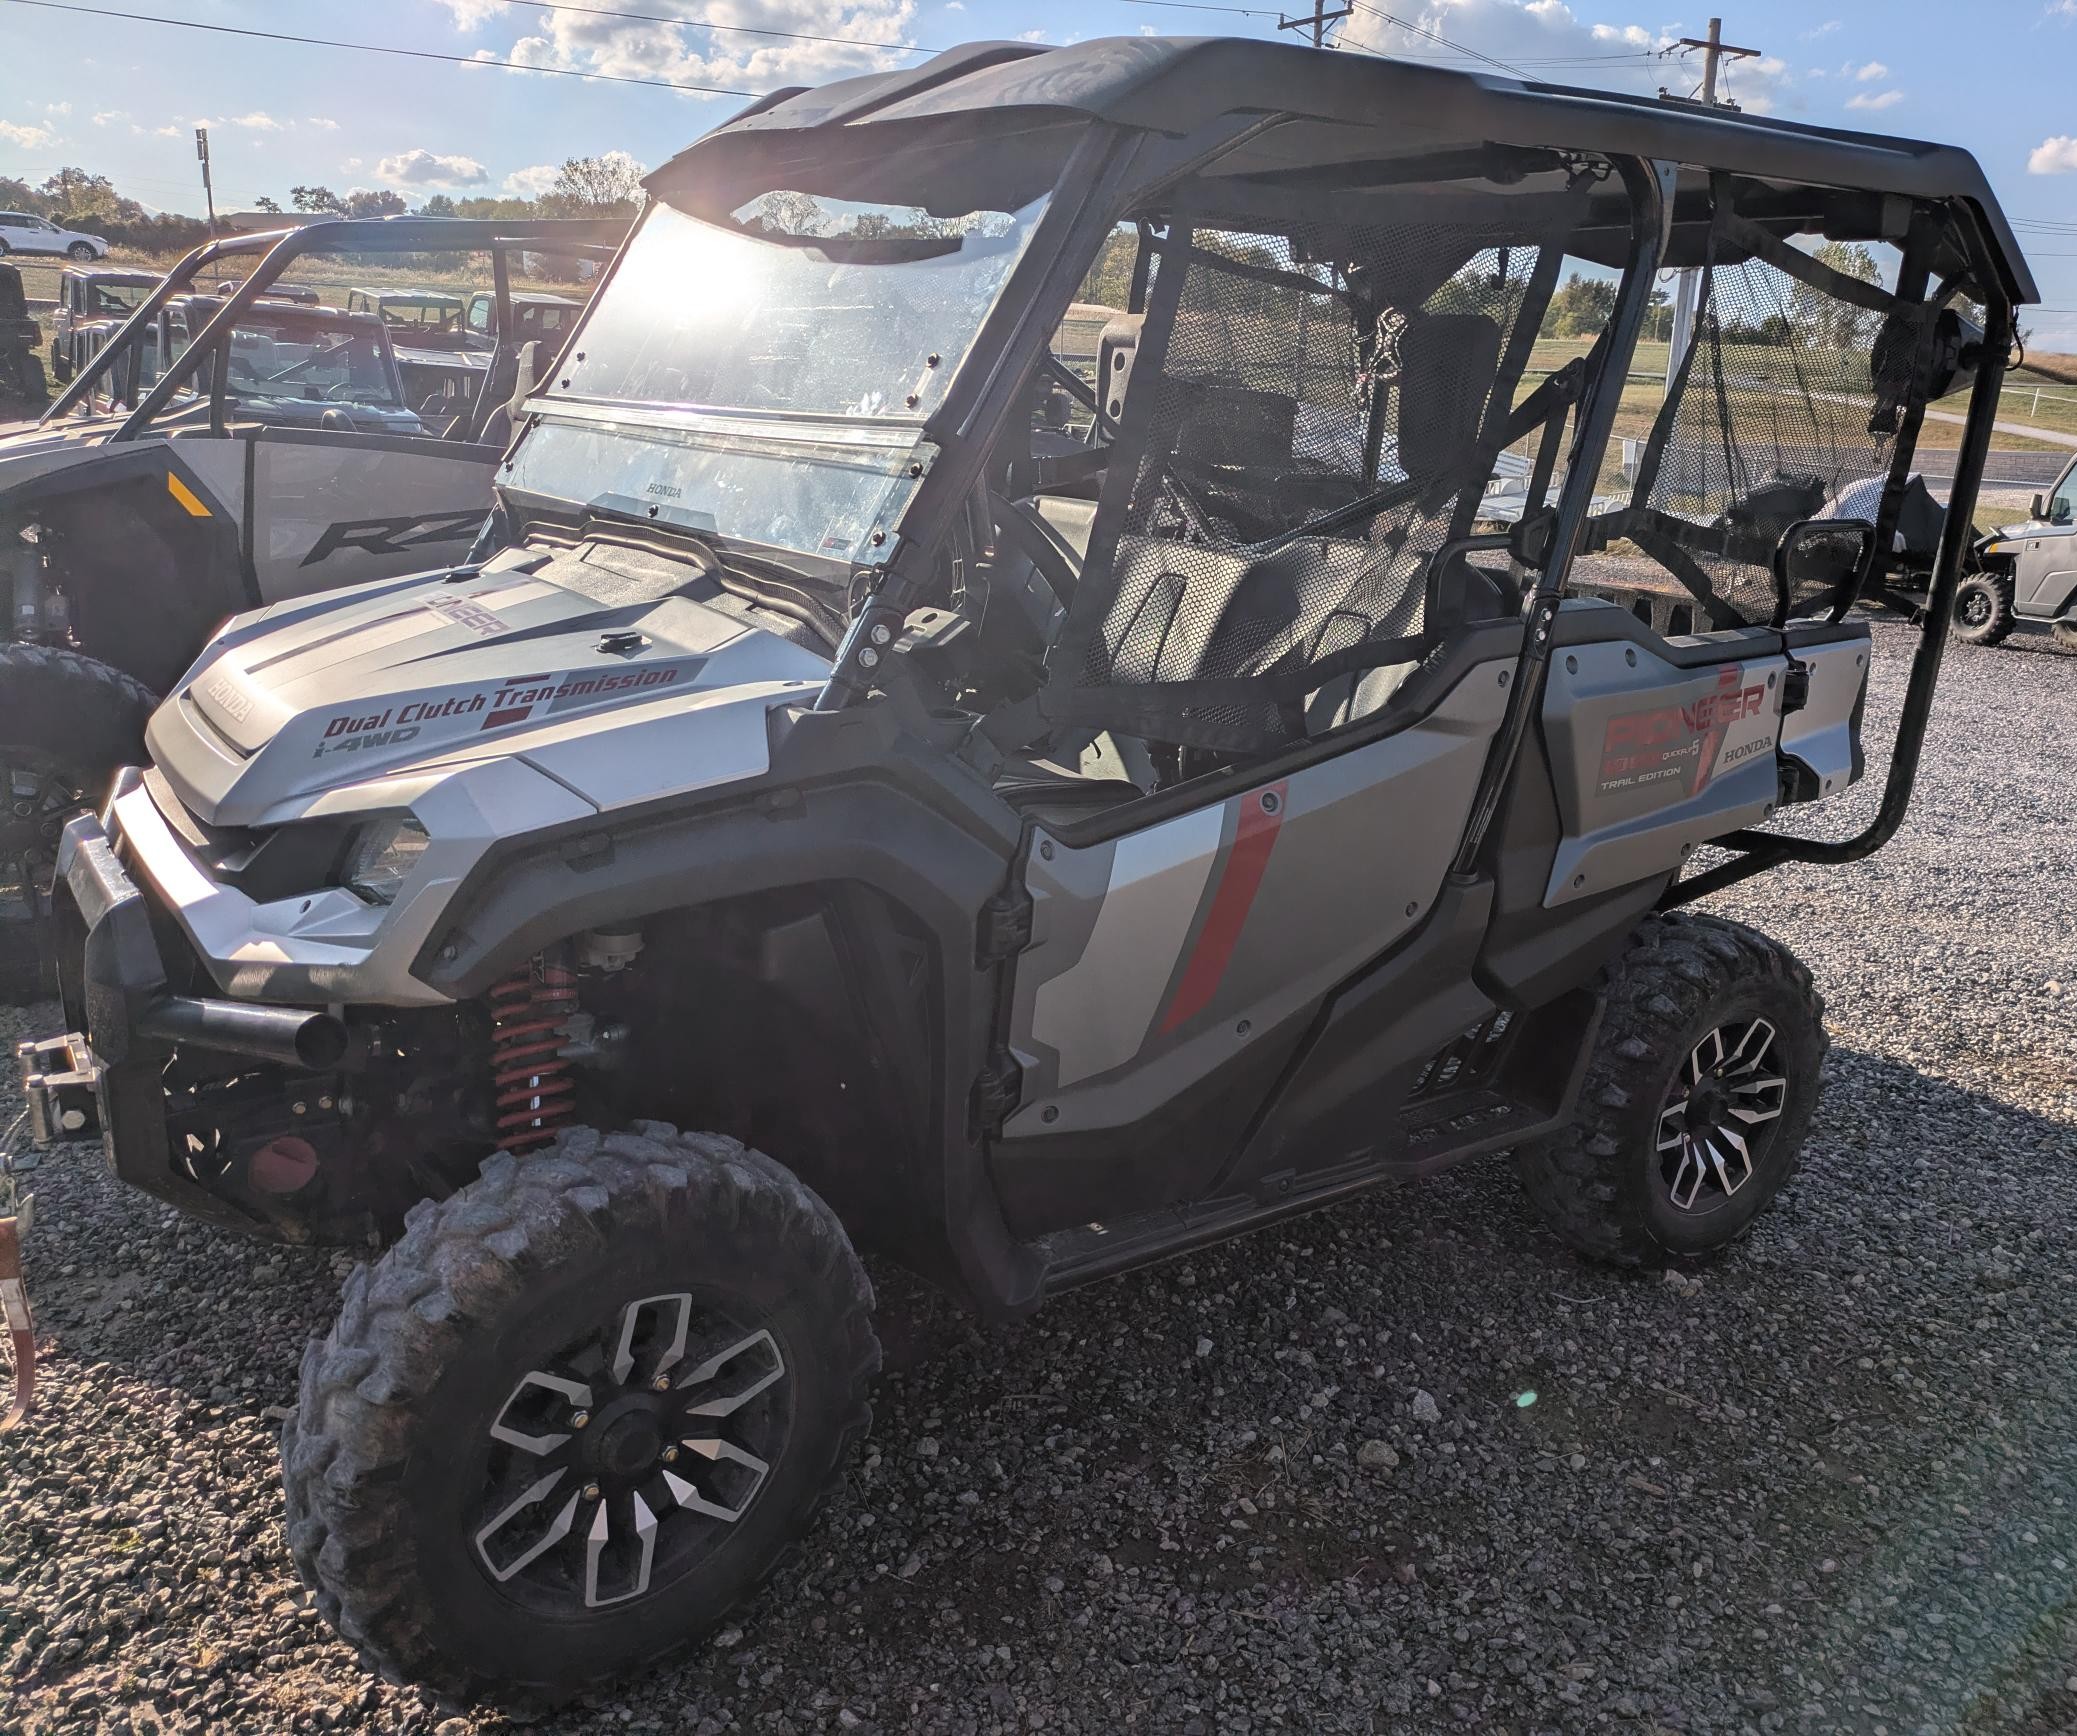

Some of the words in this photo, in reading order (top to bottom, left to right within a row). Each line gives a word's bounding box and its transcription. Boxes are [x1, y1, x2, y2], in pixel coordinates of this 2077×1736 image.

[645, 482, 682, 499] HONDA
[207, 678, 256, 723] HONDA
[323, 715, 389, 739] Dual
[396, 693, 487, 726] Clutch
[494, 668, 678, 709] Transmission
[1722, 735, 1773, 765] HONDA
[1600, 778, 1636, 791] TRAIL
[1638, 766, 1682, 783] EDITION
